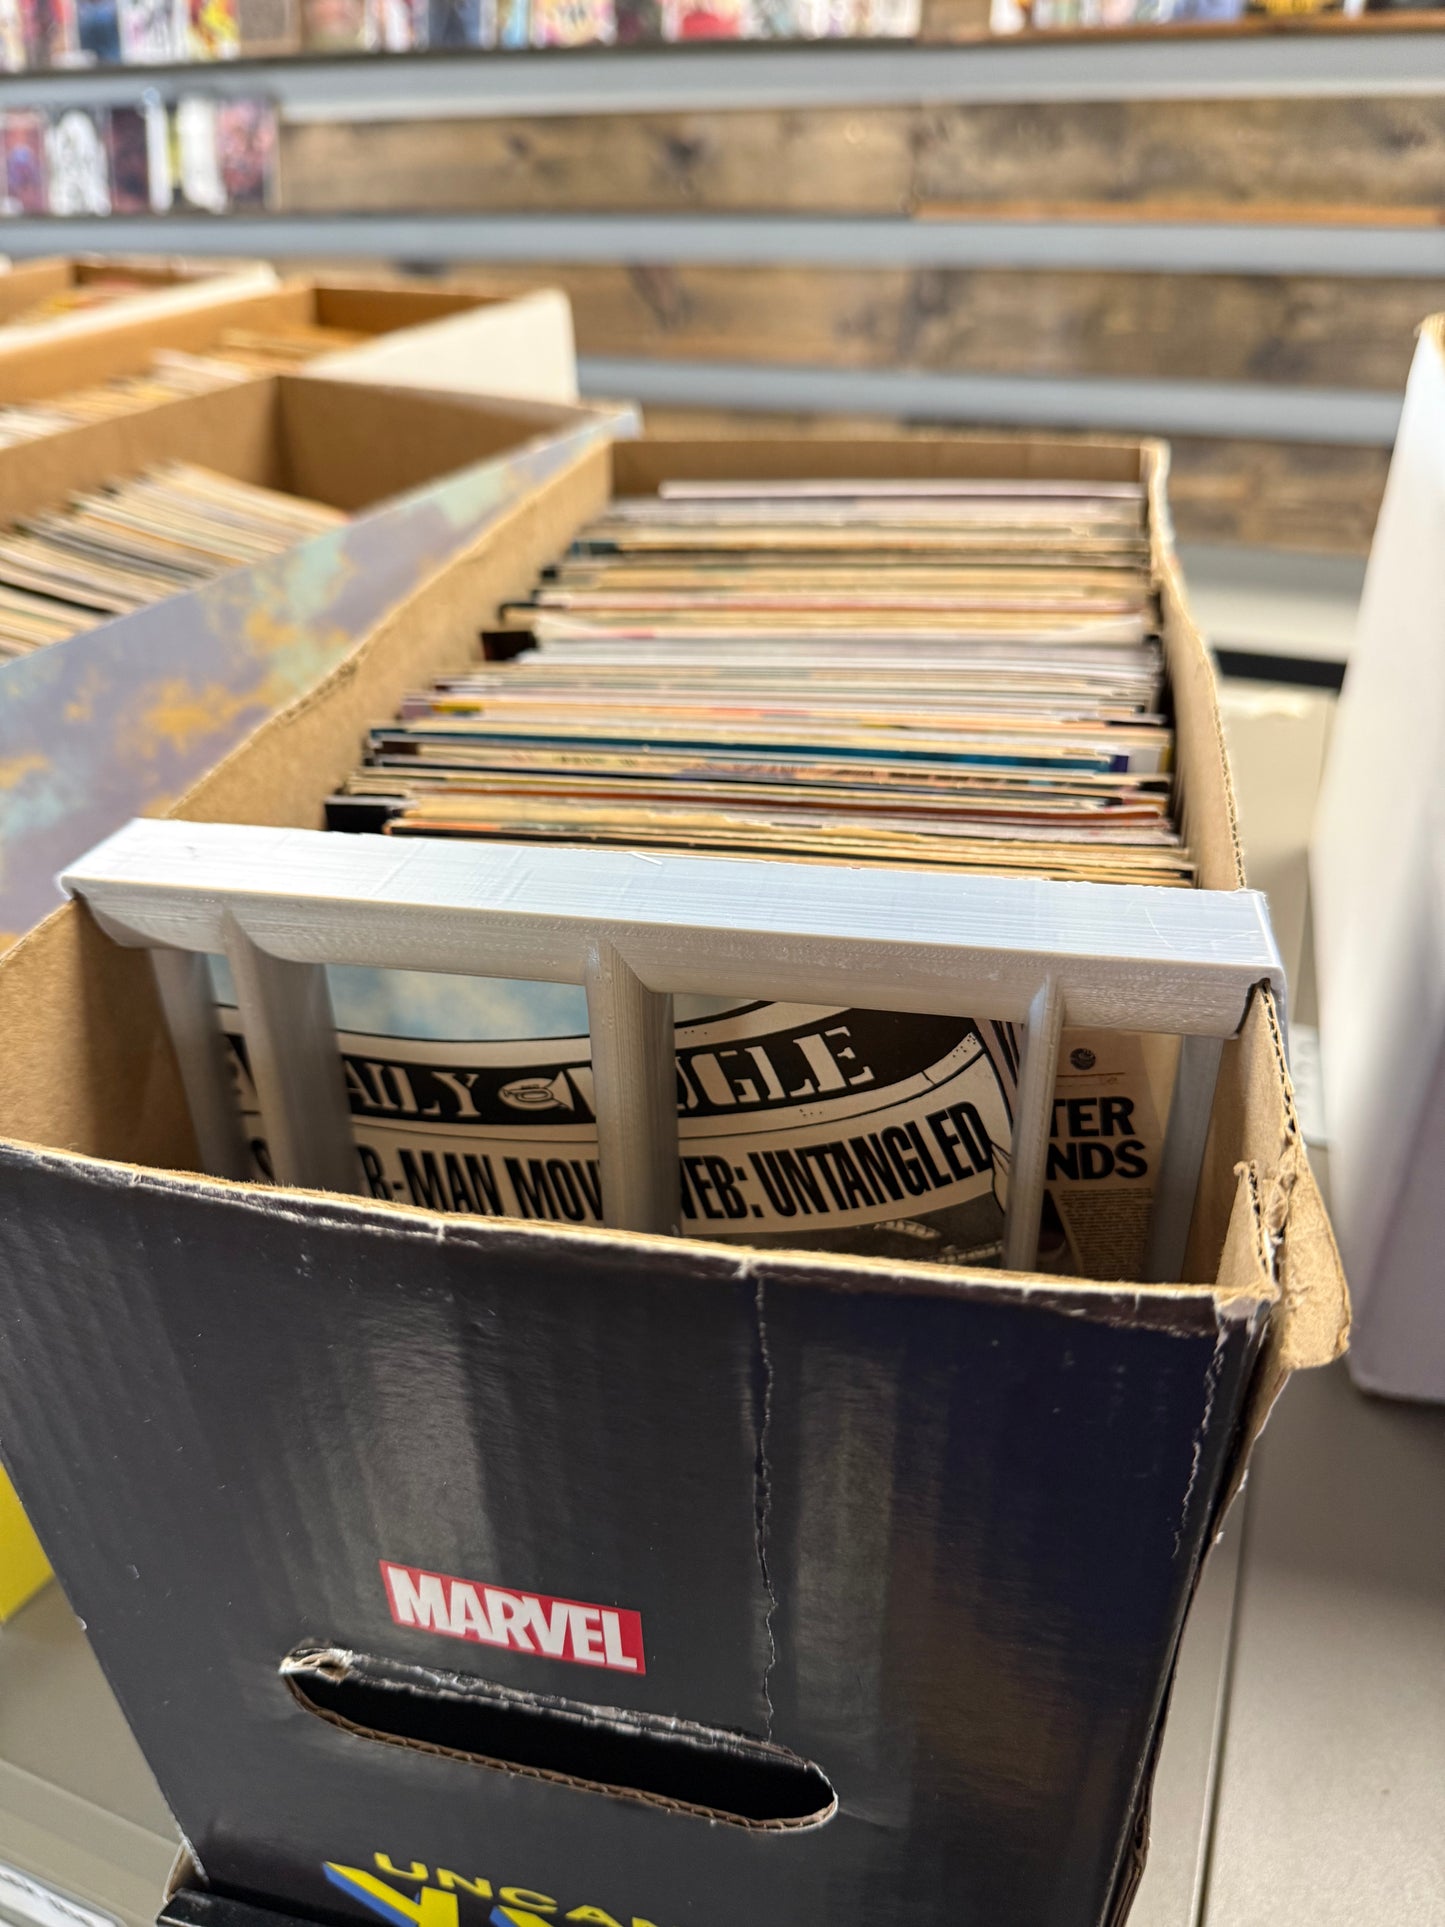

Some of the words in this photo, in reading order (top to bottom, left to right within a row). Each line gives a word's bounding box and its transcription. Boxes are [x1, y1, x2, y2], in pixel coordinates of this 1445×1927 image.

[342, 1052, 482, 1119] AILY
[1051, 1096, 1135, 1138] TER
[504, 1157, 603, 1222] MOV
[747, 1101, 994, 1218] UNTANGLED
[1046, 1139, 1148, 1181] NDS
[387, 1566, 637, 1669] MARVEL
[373, 1852, 660, 1927] UNCA
